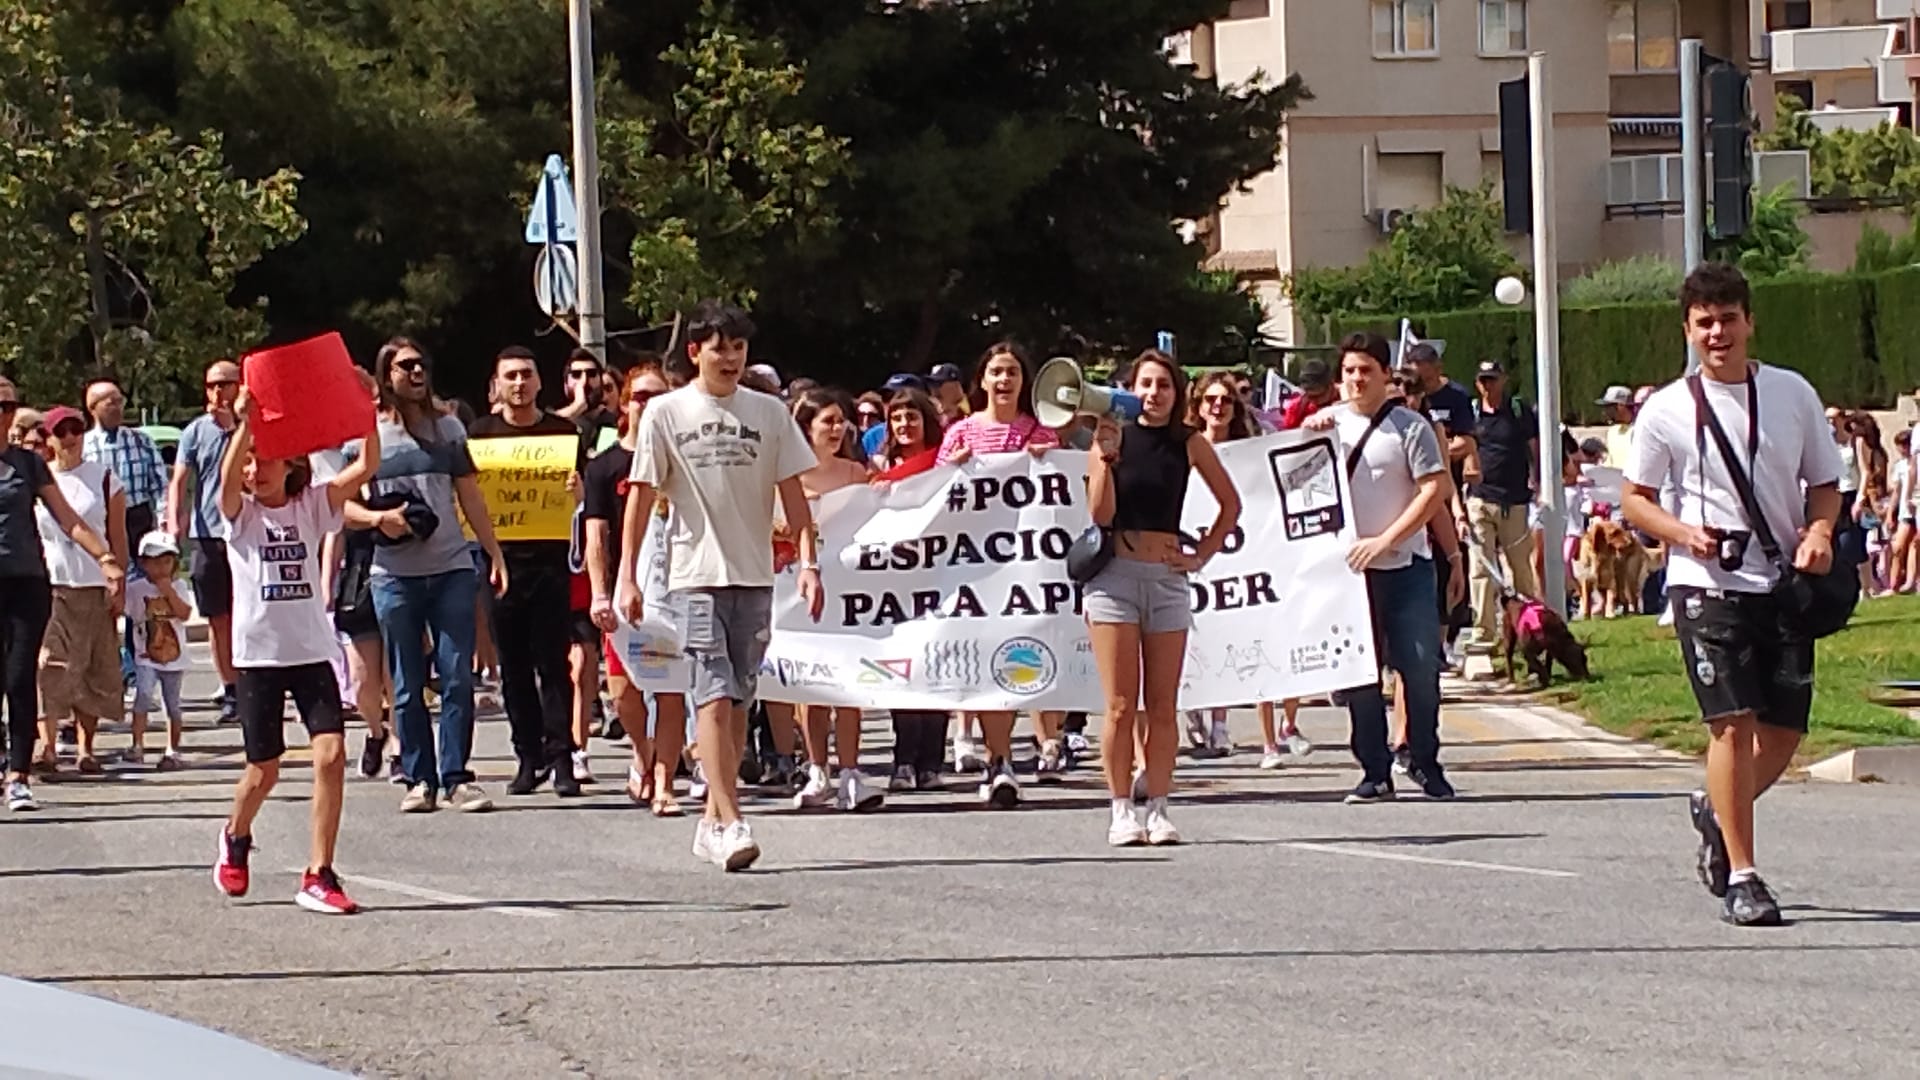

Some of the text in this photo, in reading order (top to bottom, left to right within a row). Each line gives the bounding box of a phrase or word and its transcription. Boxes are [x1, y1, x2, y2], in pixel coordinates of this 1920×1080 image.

[947, 472, 1072, 512] #POR
[855, 527, 1073, 571] ESPACIO
[839, 584, 988, 627] PARA
